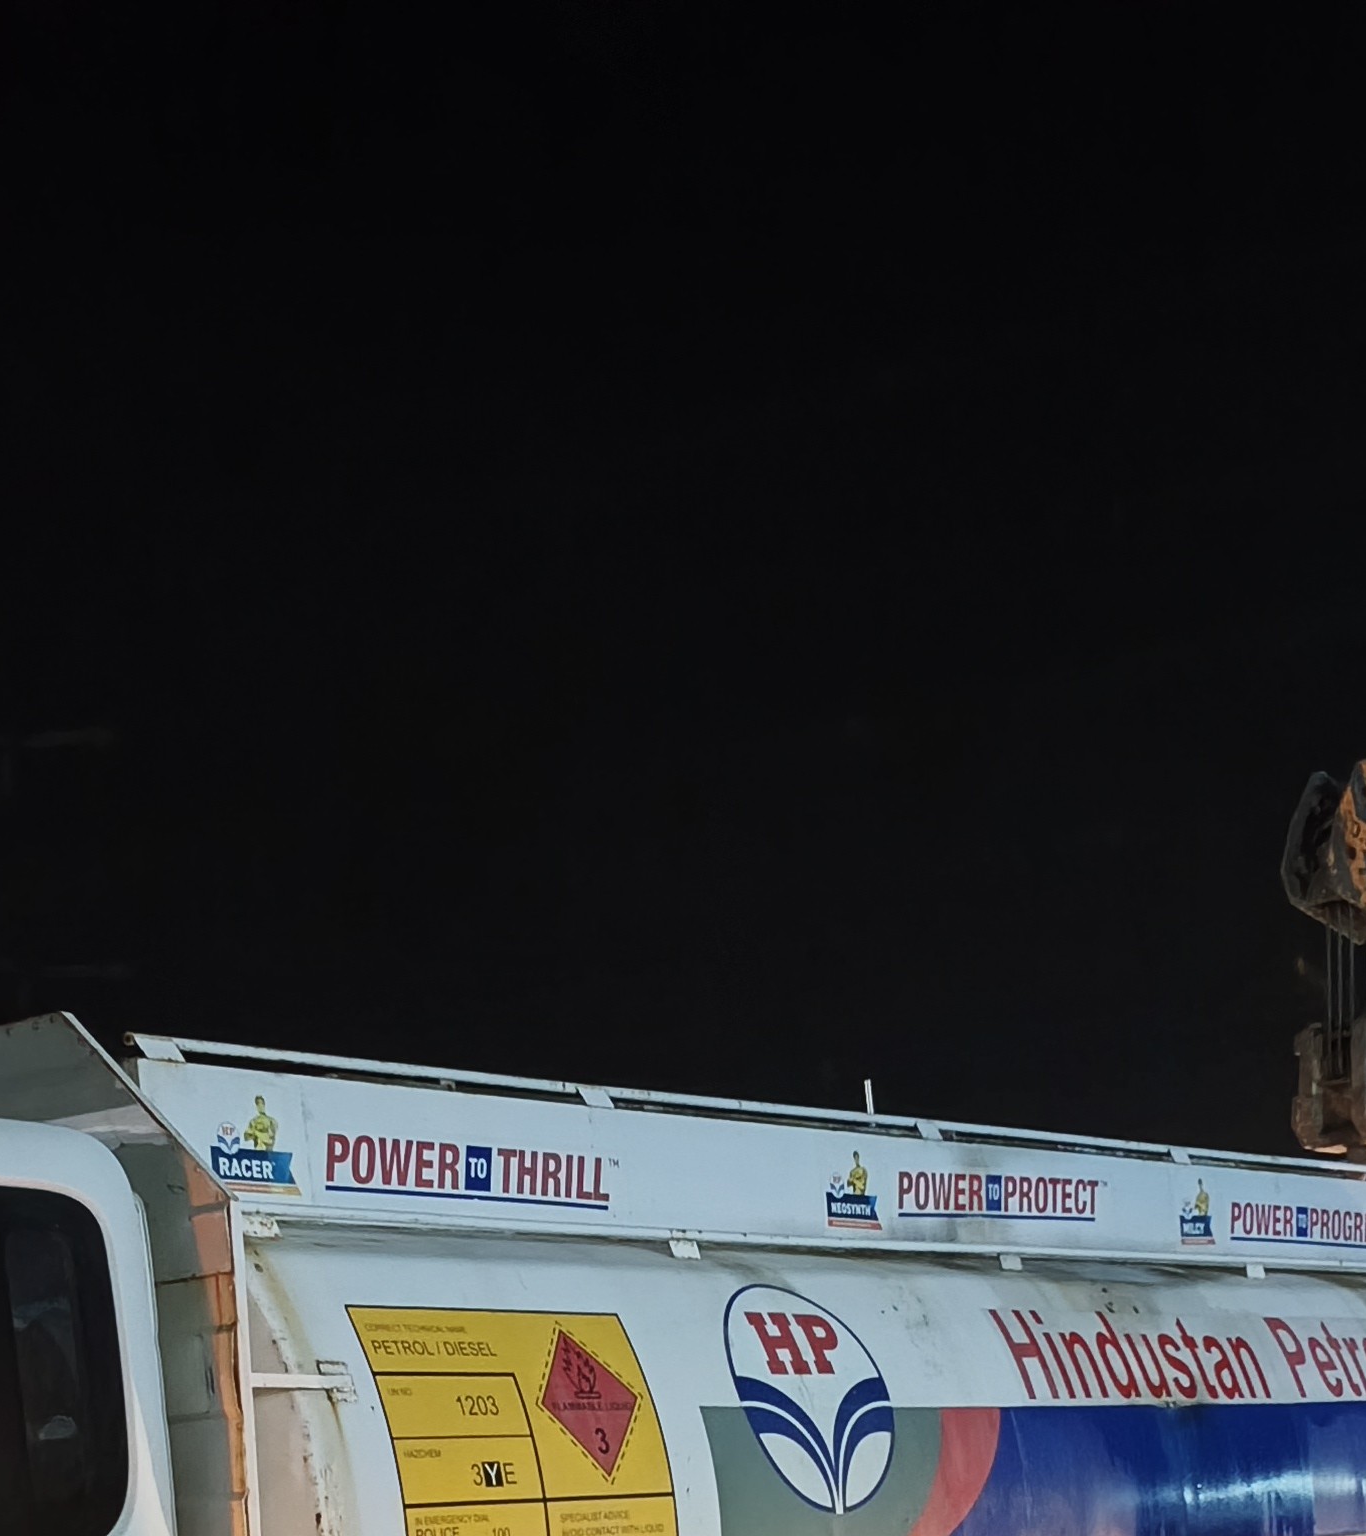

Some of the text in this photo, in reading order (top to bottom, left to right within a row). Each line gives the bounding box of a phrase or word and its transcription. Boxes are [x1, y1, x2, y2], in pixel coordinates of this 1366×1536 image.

[218, 1157, 274, 1179] RACER
[325, 1133, 460, 1190] POWER
[468, 1157, 488, 1179] TO
[497, 1147, 610, 1202] THRILL
[898, 1171, 1099, 1215] POWER TO PROTECT
[1230, 1202, 1294, 1237] POWER
[371, 1340, 434, 1357] PETROL
[444, 1342, 497, 1357] DIESEL
[744, 1311, 838, 1375] HP
[988, 1309, 1272, 1400] Hindustan
[455, 1395, 500, 1416] 1203
[595, 1428, 610, 1454] 3
[471, 1462, 517, 1488] 3YE
